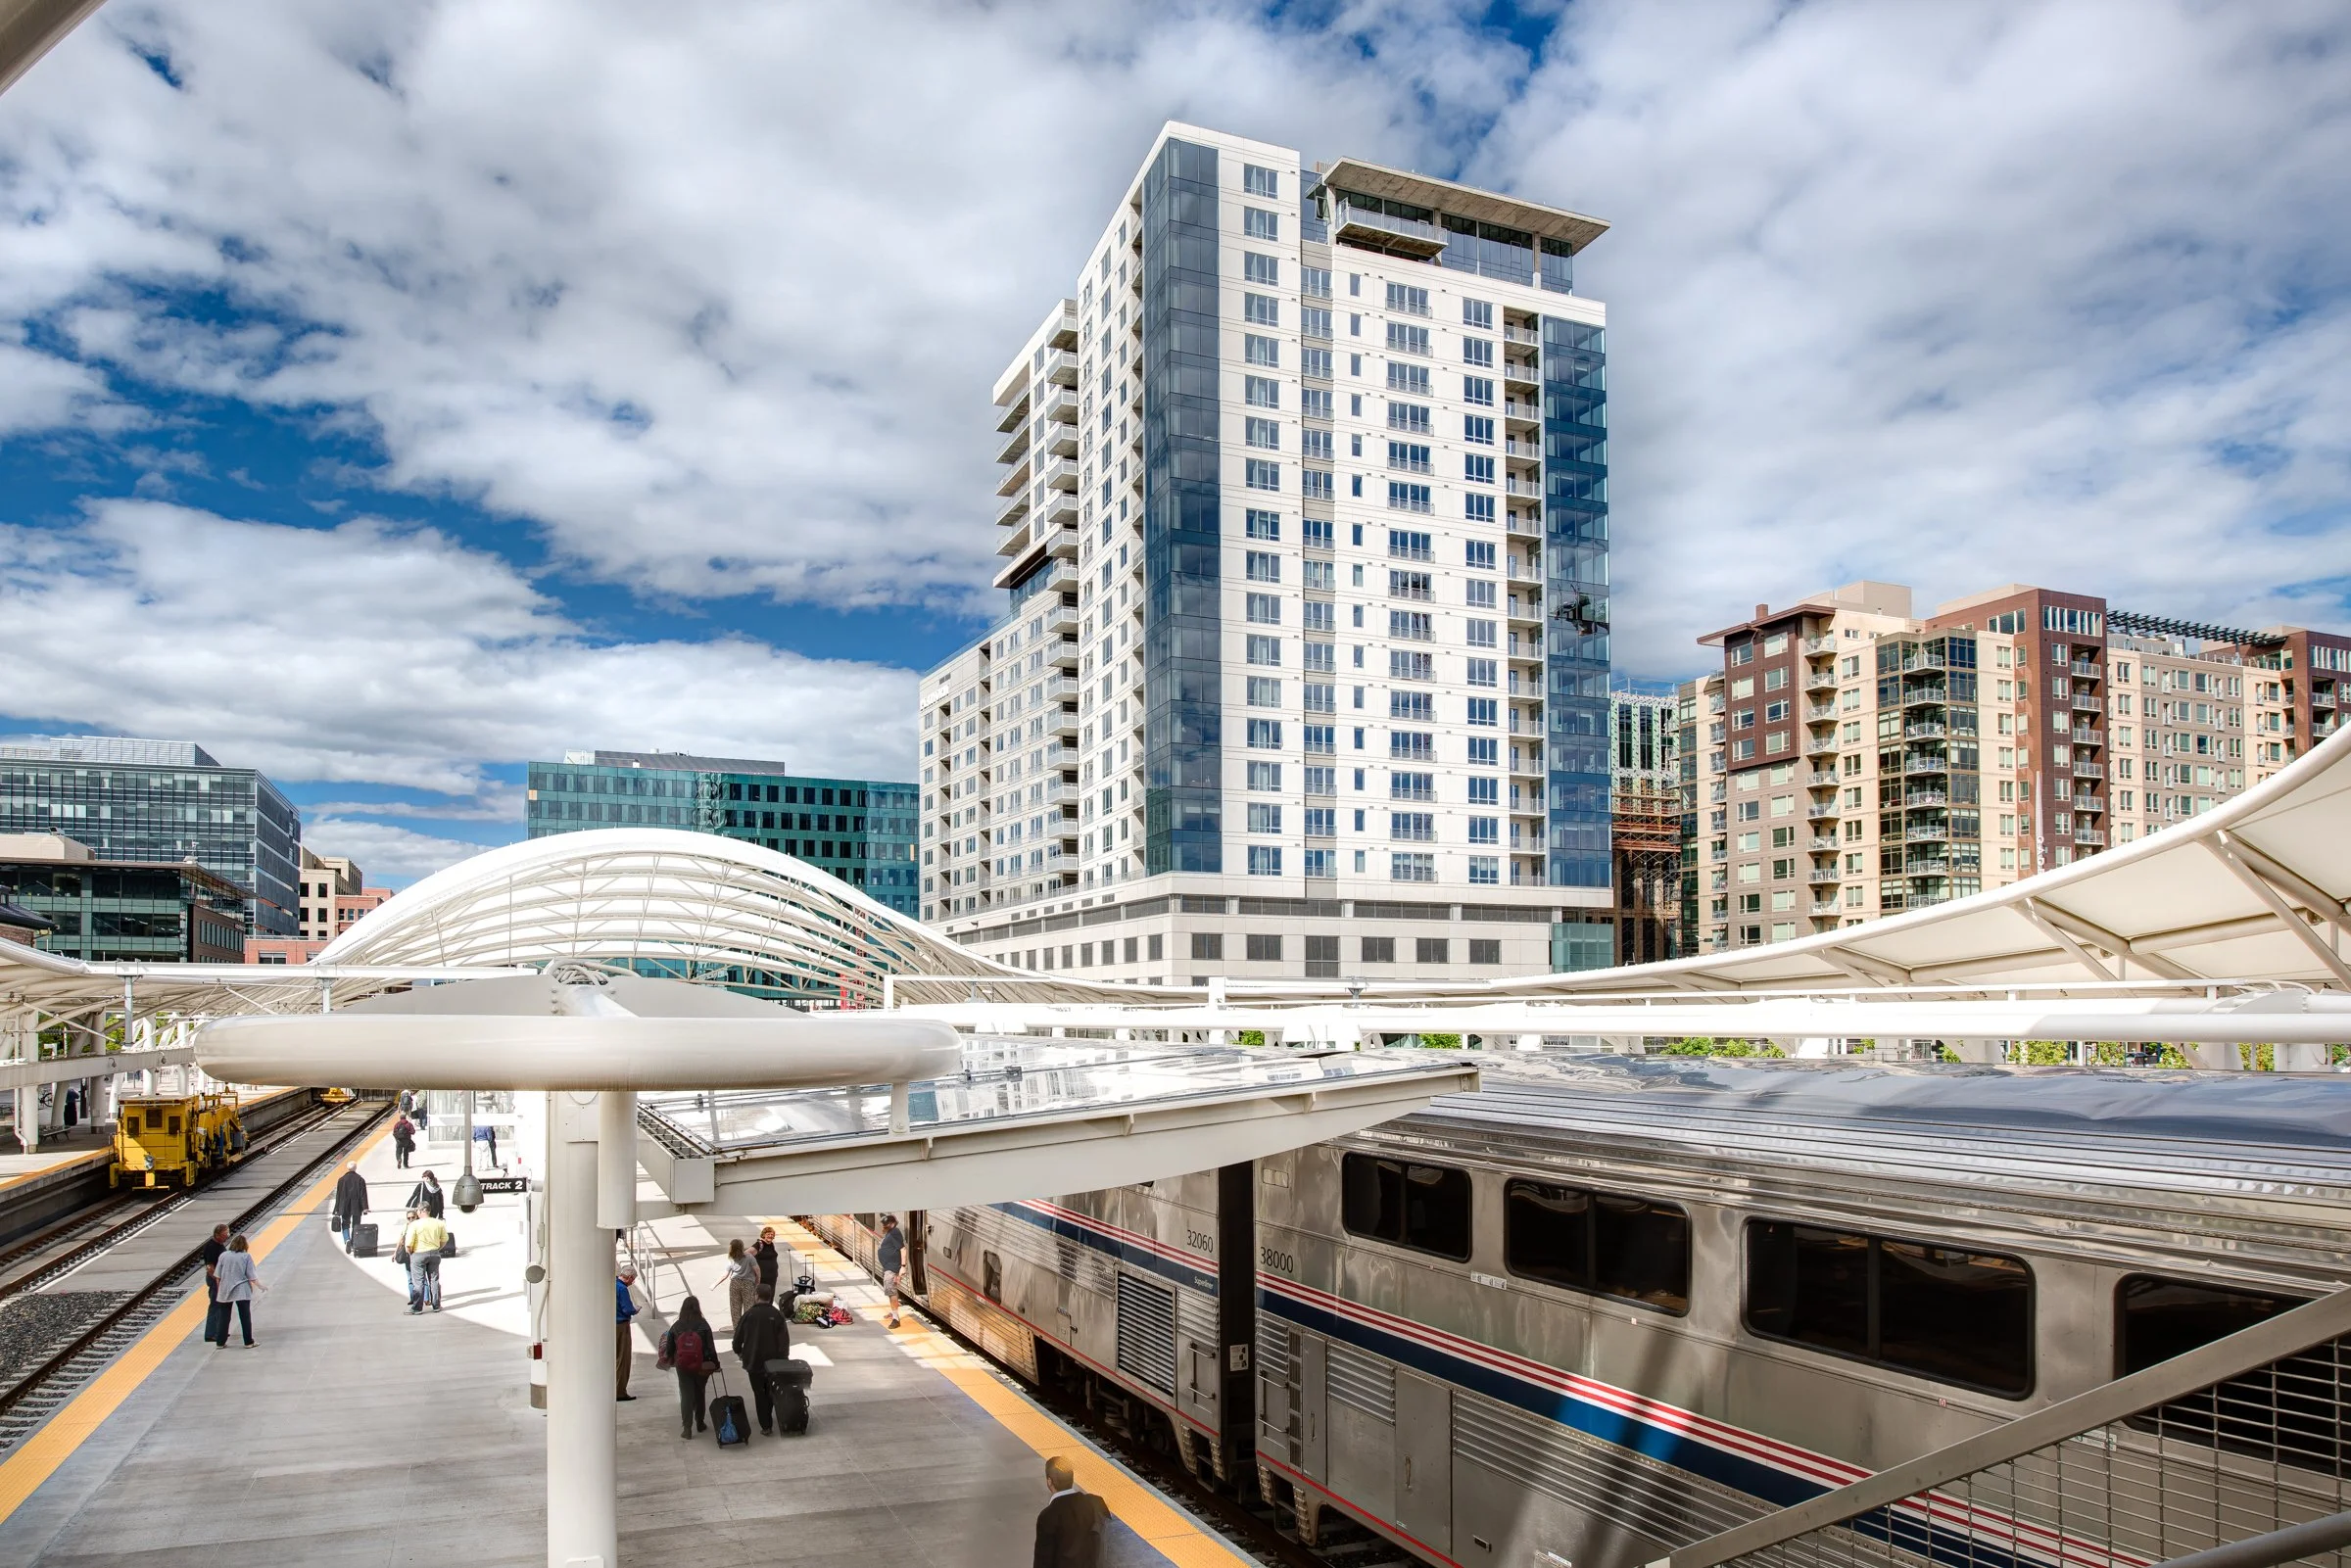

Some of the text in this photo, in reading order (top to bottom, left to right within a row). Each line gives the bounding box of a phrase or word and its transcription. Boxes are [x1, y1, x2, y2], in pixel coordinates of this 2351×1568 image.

[480, 1180, 523, 1190] TRACK 2
[1186, 1229, 1214, 1254] 32060
[1260, 1246, 1293, 1273] 38000
